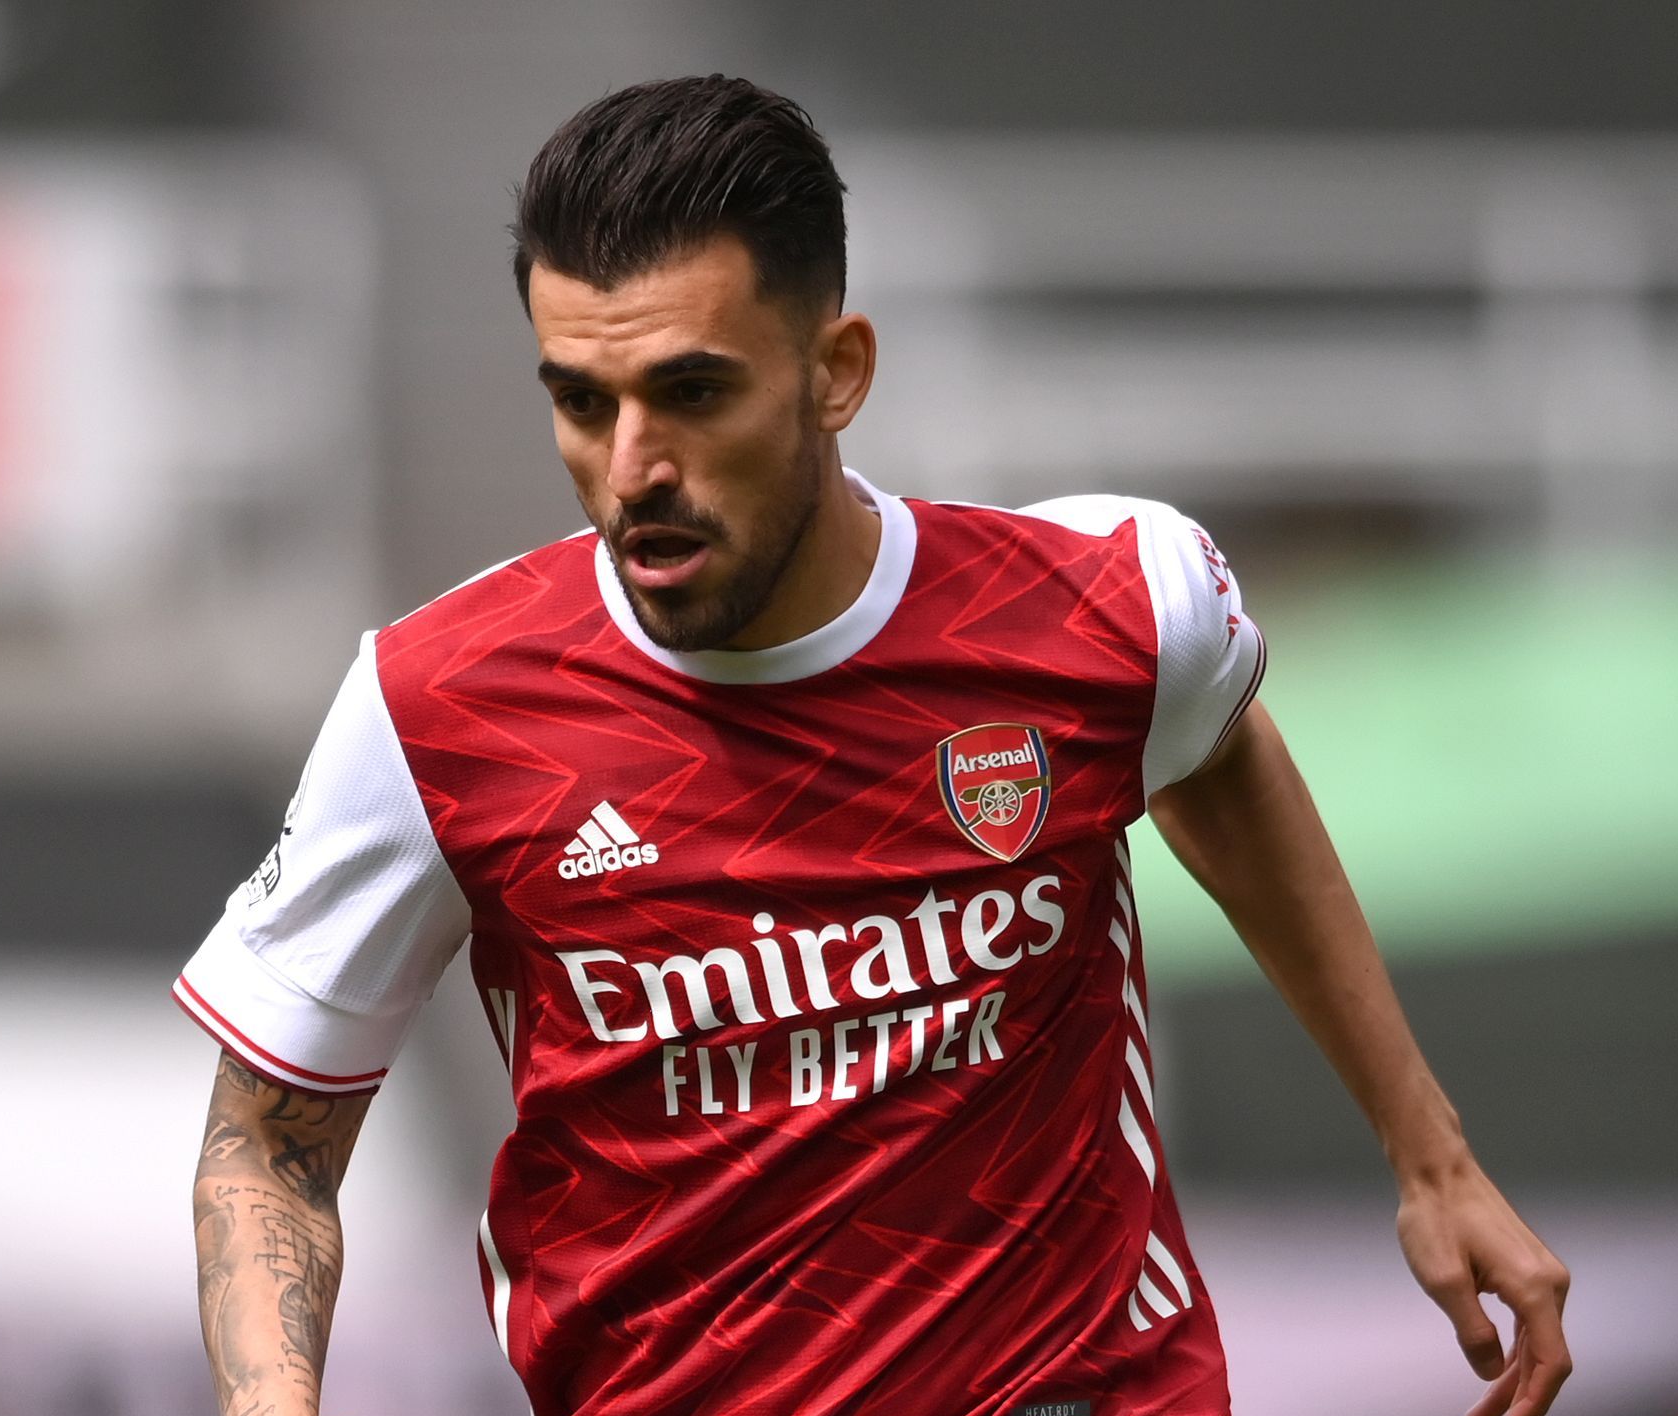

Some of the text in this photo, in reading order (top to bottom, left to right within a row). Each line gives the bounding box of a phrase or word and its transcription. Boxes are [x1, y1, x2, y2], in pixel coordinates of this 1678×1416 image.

[953, 742, 1033, 775] Arsenal
[557, 843, 660, 880] adidas
[555, 874, 1066, 1044] Emirates
[661, 990, 1007, 1117] FLY BETTER
